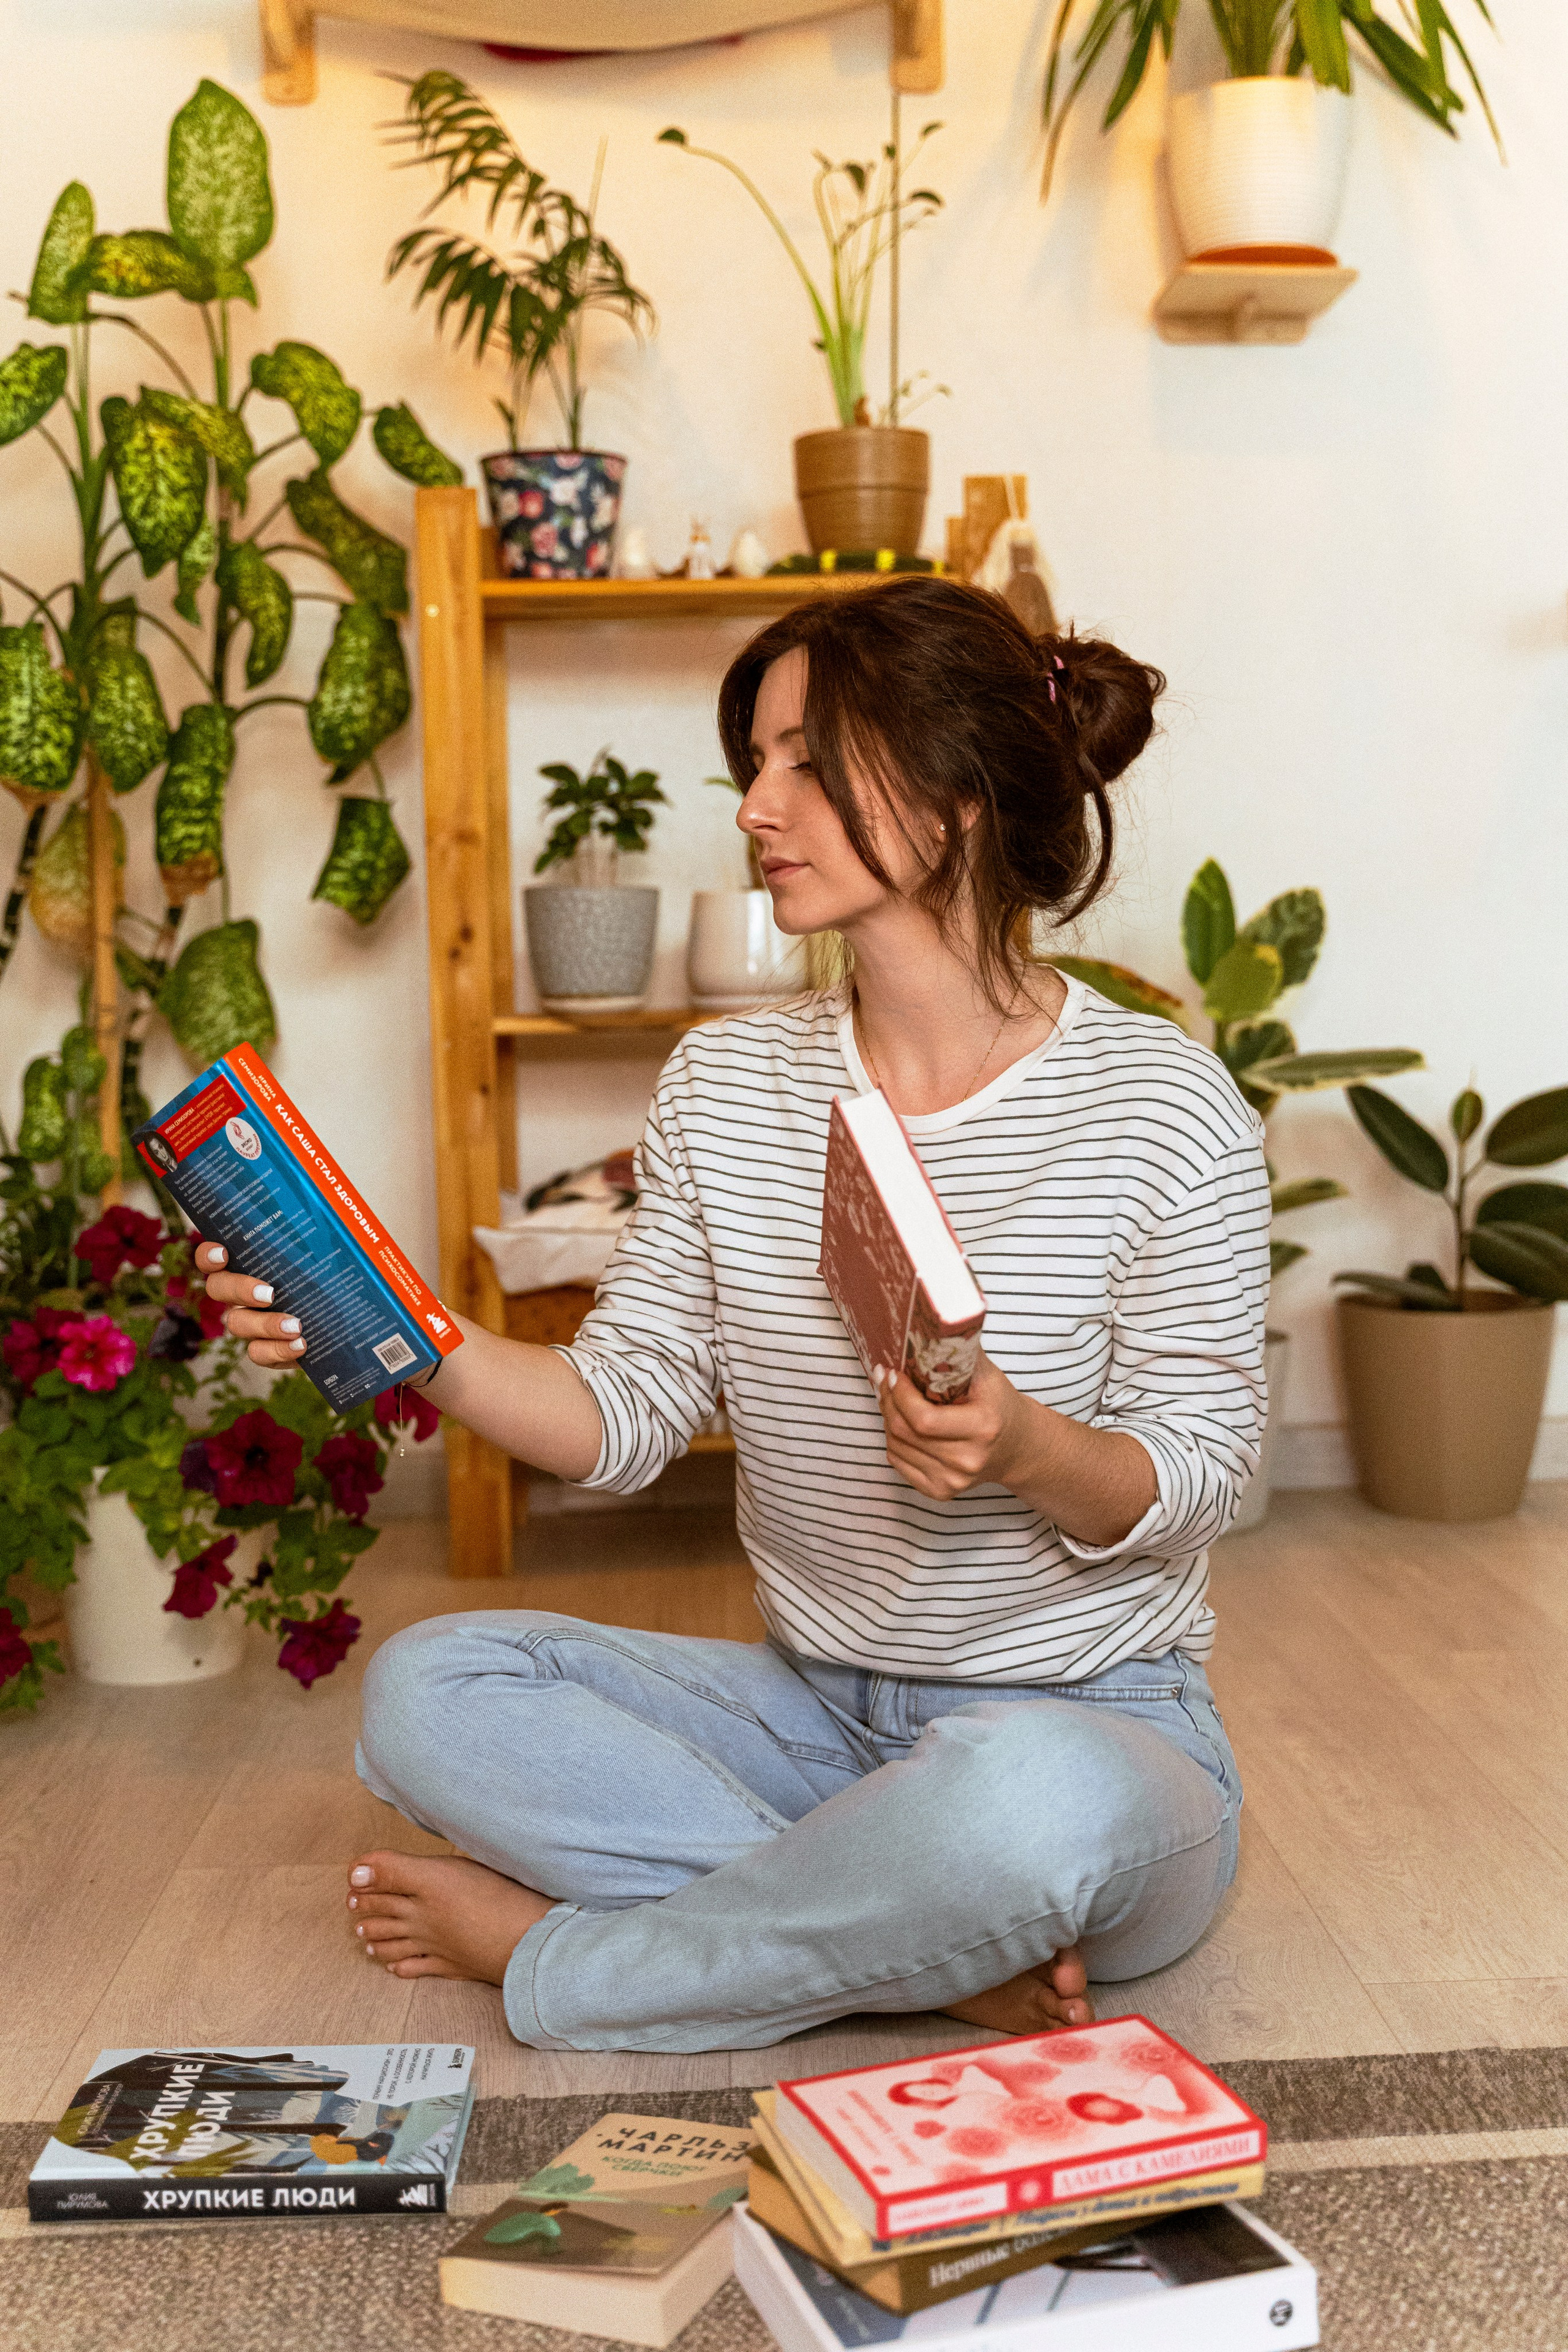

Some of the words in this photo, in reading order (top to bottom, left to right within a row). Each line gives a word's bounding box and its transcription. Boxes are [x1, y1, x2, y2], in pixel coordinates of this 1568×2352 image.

[237, 1057, 272, 1102] СЕМИЗОРОВА
[257, 1074, 277, 1098] ИРИНА
[164, 1123, 176, 1135] ИРИНА
[173, 1107, 195, 1126] СЕМИЗОРОВА
[274, 1102, 295, 1127] КАК
[290, 1124, 318, 1158] САША
[312, 1155, 337, 1185] СТАЛ
[333, 1182, 380, 1244] ЗДОРОВЫМ
[242, 1228, 257, 1242] КНИГА
[253, 1215, 275, 1233] ПОМОЖЕТ
[377, 1249, 421, 1306] ПСИХОСОМАТИКЕ
[383, 1245, 415, 1285] ПРАКТИКУМ
[411, 1283, 422, 1295] ПО
[323, 1373, 339, 1385] БОМБОРА
[129, 2064, 205, 2160] ХРУПКИЕ
[176, 2092, 236, 2157] ЛЮДИ
[597, 2139, 746, 2162] МАРТИН
[619, 2128, 750, 2151] ЧАРЛЬЗ
[1118, 2162, 1130, 2180] С
[143, 2189, 265, 2210] ХРУПКИЕ
[273, 2187, 356, 2209] ЛЮДИ
